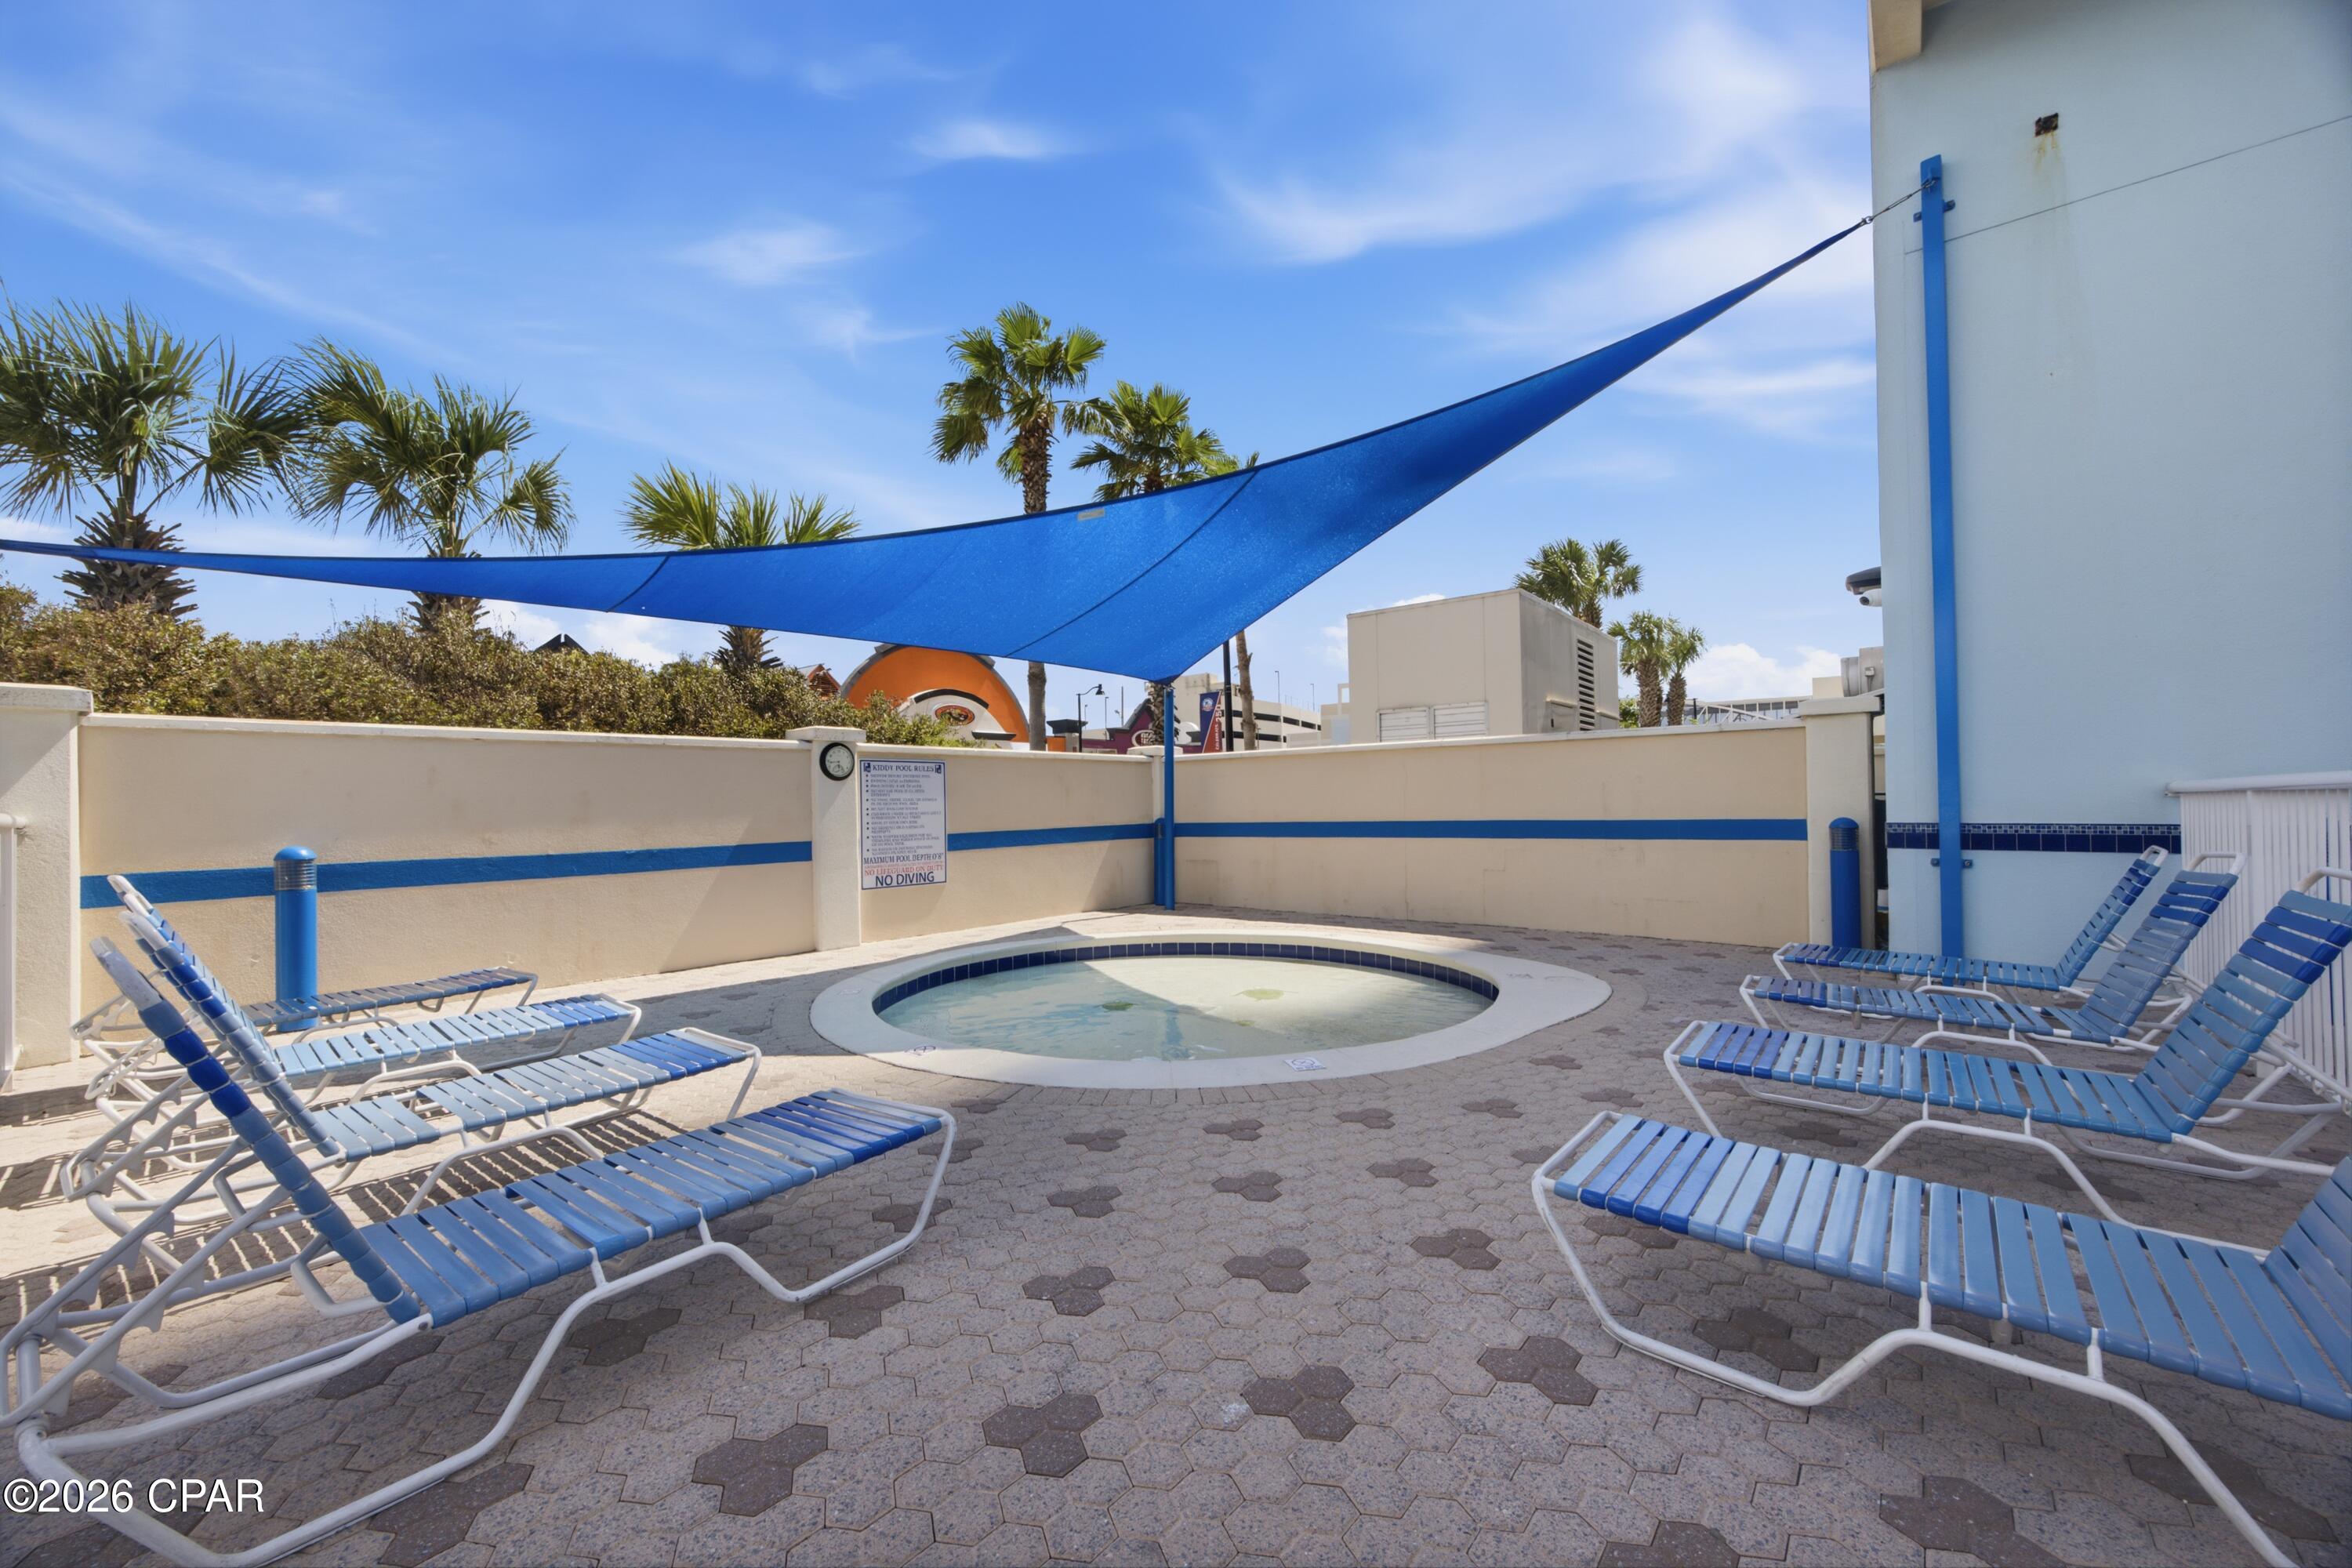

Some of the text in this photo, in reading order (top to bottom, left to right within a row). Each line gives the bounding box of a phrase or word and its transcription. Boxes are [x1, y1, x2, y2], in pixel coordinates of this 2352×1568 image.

[863, 855, 895, 865] MAXIMUM
[896, 854, 911, 862] POOL
[912, 853, 931, 862] DEPTH
[877, 866, 915, 876] LIFEGUARD
[875, 871, 935, 887] NO DIVING
